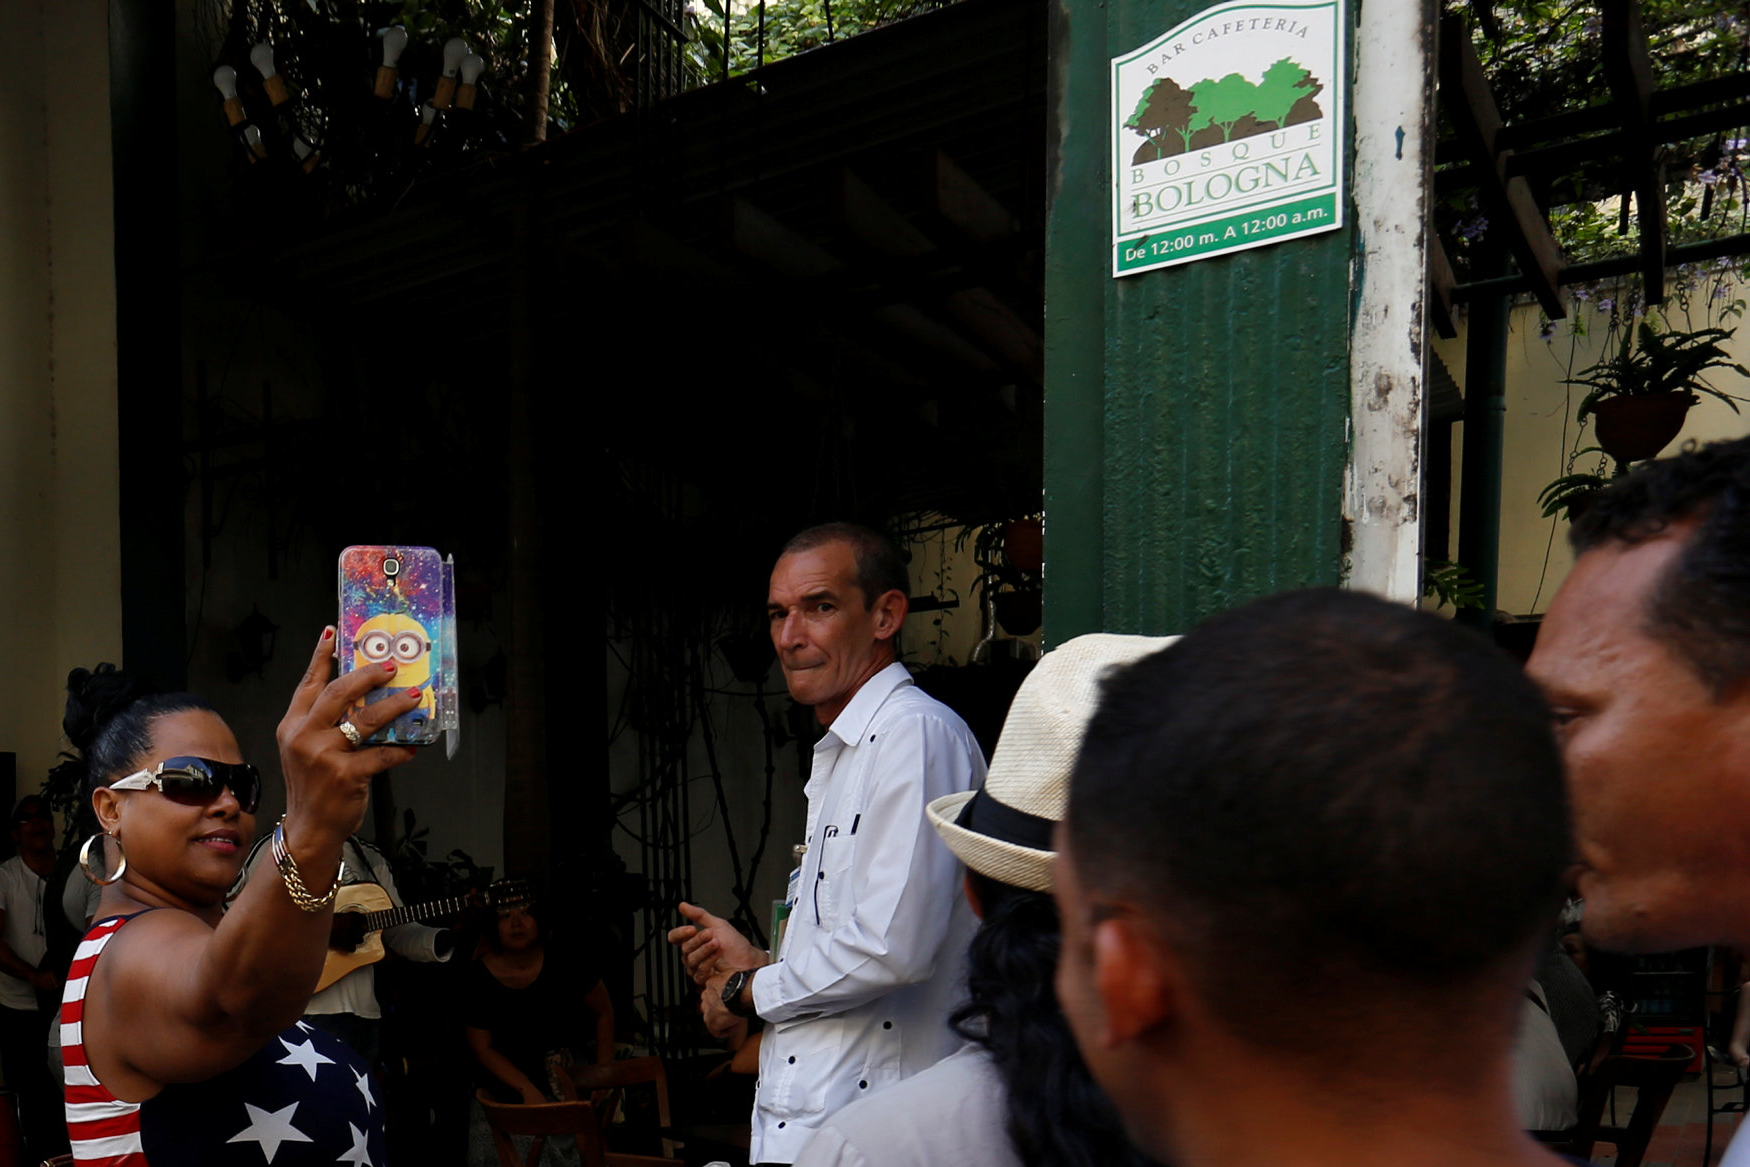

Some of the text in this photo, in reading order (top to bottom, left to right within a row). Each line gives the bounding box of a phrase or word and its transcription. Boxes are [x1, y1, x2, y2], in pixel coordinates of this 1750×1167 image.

[1146, 17, 1309, 75] BAR CAFETERIA
[1131, 123, 1321, 184] BOSQUE
[1132, 152, 1321, 219] BOLOGNA
[1125, 206, 1329, 262] De 12:00 m. A 12:00 a.m.
